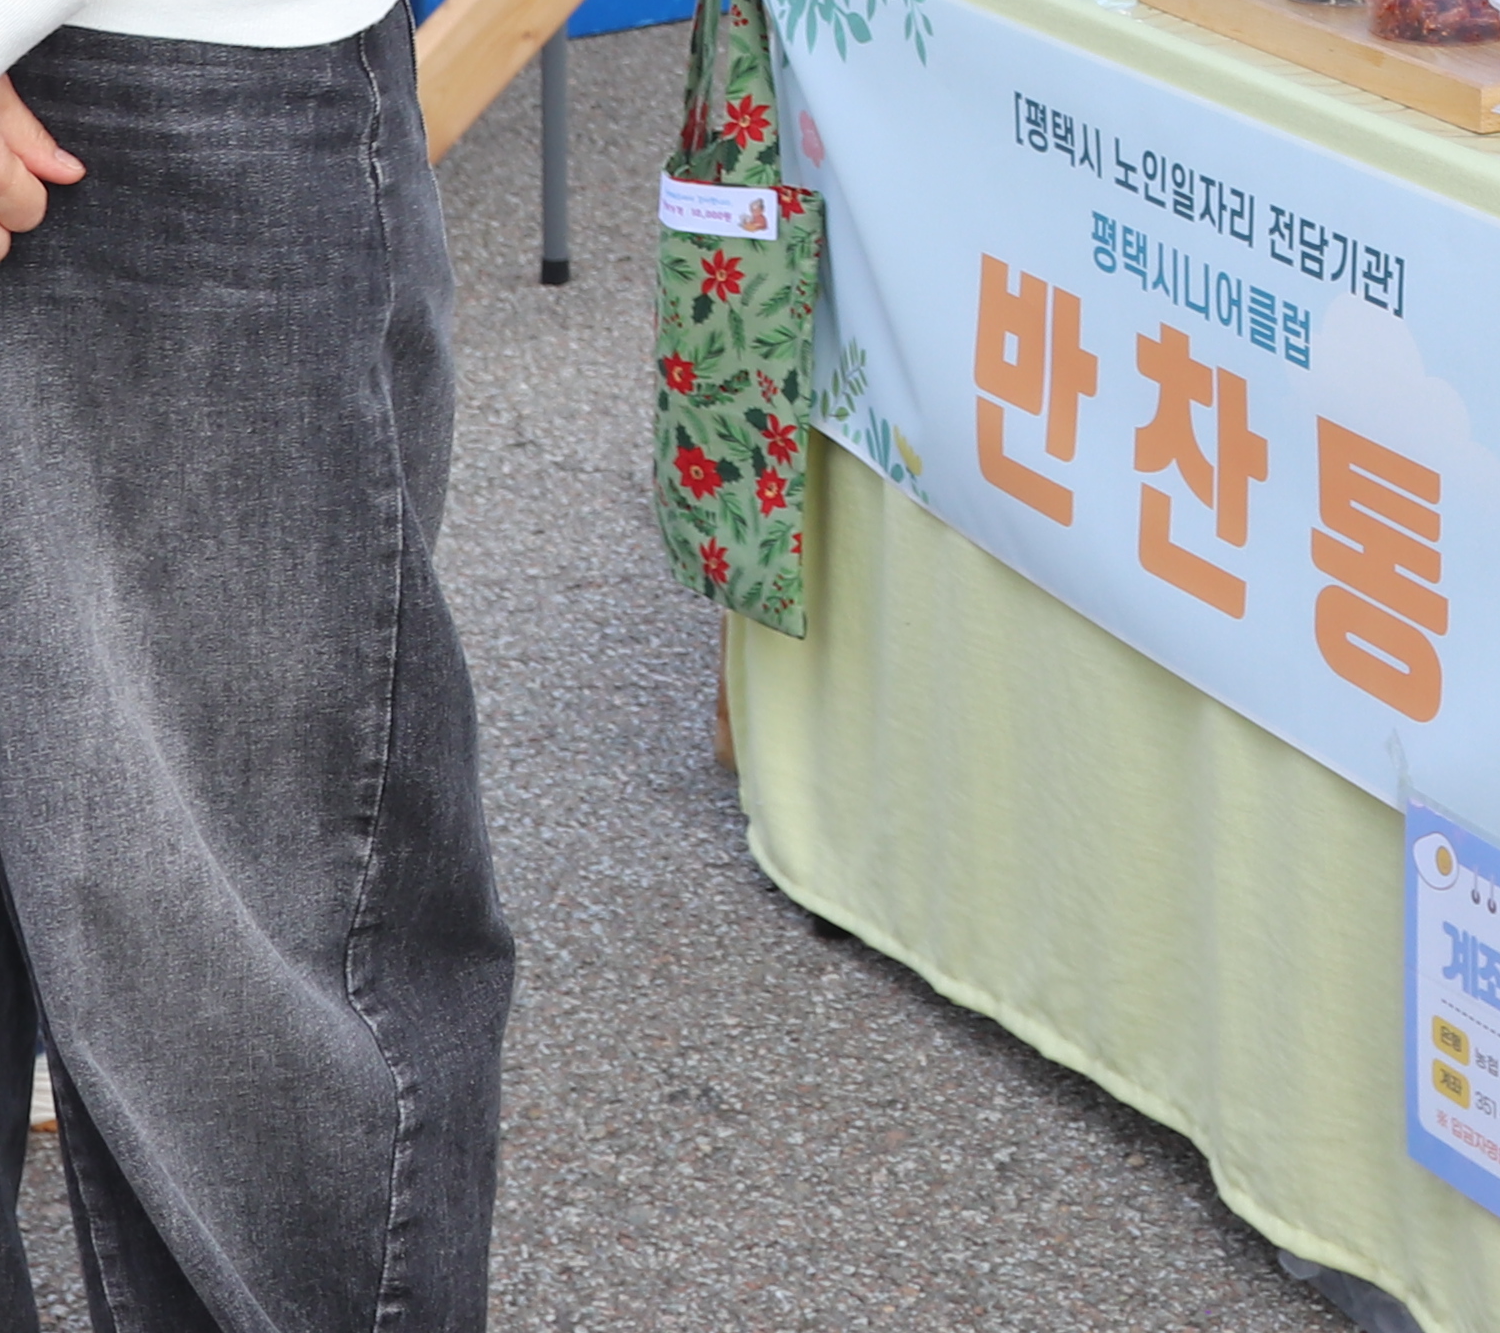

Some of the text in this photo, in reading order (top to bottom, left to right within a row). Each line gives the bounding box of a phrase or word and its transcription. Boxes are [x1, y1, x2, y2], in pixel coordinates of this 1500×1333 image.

[1013, 89, 1407, 321] [평택시 노인일자리 전담기관]
[1090, 208, 1313, 372] 평택시니어클럽
[1439, 1067, 1463, 1097] 계좌
[1440, 1025, 1500, 1077] 은행 농협
